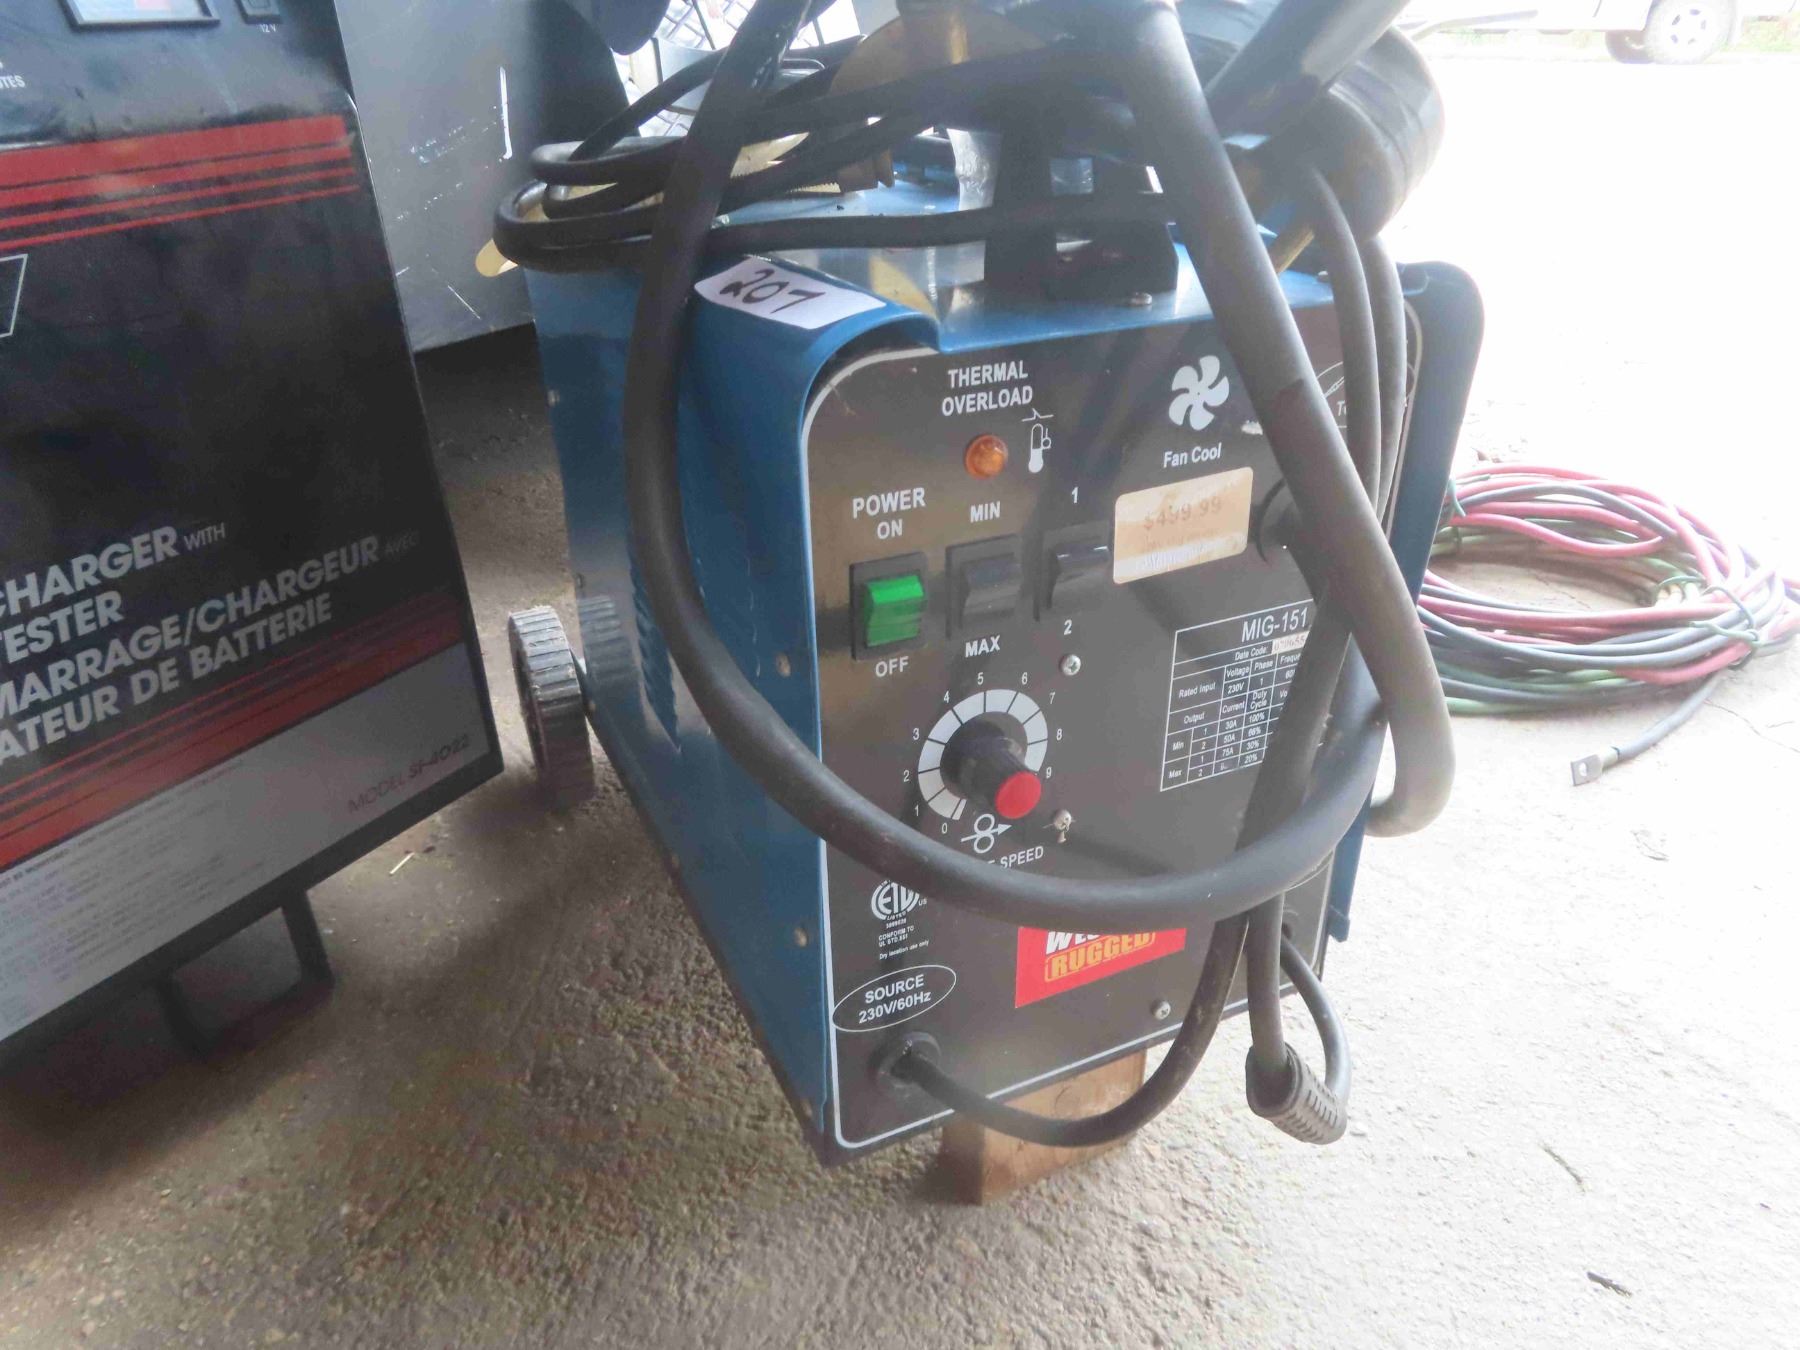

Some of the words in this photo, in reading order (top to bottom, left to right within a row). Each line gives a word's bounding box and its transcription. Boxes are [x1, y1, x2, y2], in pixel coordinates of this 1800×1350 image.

[0, 75, 26, 89] TES
[719, 269, 827, 314] 207
[948, 360, 1029, 389] THERMAL
[941, 385, 1033, 416] OVERLOAD
[1163, 450, 1188, 468] Fan
[1191, 442, 1222, 463] Cool
[1071, 486, 1079, 504] 1
[852, 487, 927, 518] POWER
[969, 501, 1001, 523] MIN
[877, 519, 903, 540] ON
[0, 525, 180, 615] HARGER
[184, 522, 227, 552] WITH
[1063, 619, 1072, 635] 2
[1241, 607, 1308, 643] MIG-151
[965, 635, 1001, 658] MAX
[875, 656, 909, 678] OFF
[1226, 666, 1250, 679] Voltage
[1254, 660, 1274, 671] Phase
[0, 686, 120, 766] ATEUR
[131, 657, 181, 705] DE
[190, 592, 333, 681] BATTERIE
[977, 671, 985, 685] 5
[1021, 671, 1028, 685] 6
[1178, 686, 1198, 699] Rated
[1200, 681, 1217, 696] Input
[1227, 682, 1245, 695] 230V
[1252, 690, 1267, 701] Duty
[943, 690, 950, 703] 4
[1049, 691, 1056, 704] 7
[1222, 701, 1245, 714] Current
[1250, 700, 1267, 711] Cycle
[1183, 712, 1206, 726] Output
[1249, 712, 1265, 723] 100%
[912, 727, 920, 740] 3
[1056, 728, 1063, 741] 8
[1172, 741, 1185, 751] Min
[903, 770, 910, 782] 2
[1045, 766, 1052, 779] 9
[1168, 769, 1182, 779] Max
[914, 805, 919, 817] 1
[941, 822, 948, 834] 0
[999, 845, 1044, 869] SPEED
[879, 952, 888, 960] Dry
[1051, 931, 1151, 980] RUGGED
[865, 974, 925, 1004] SOURCE
[858, 991, 932, 1024] 230V/60Hz
